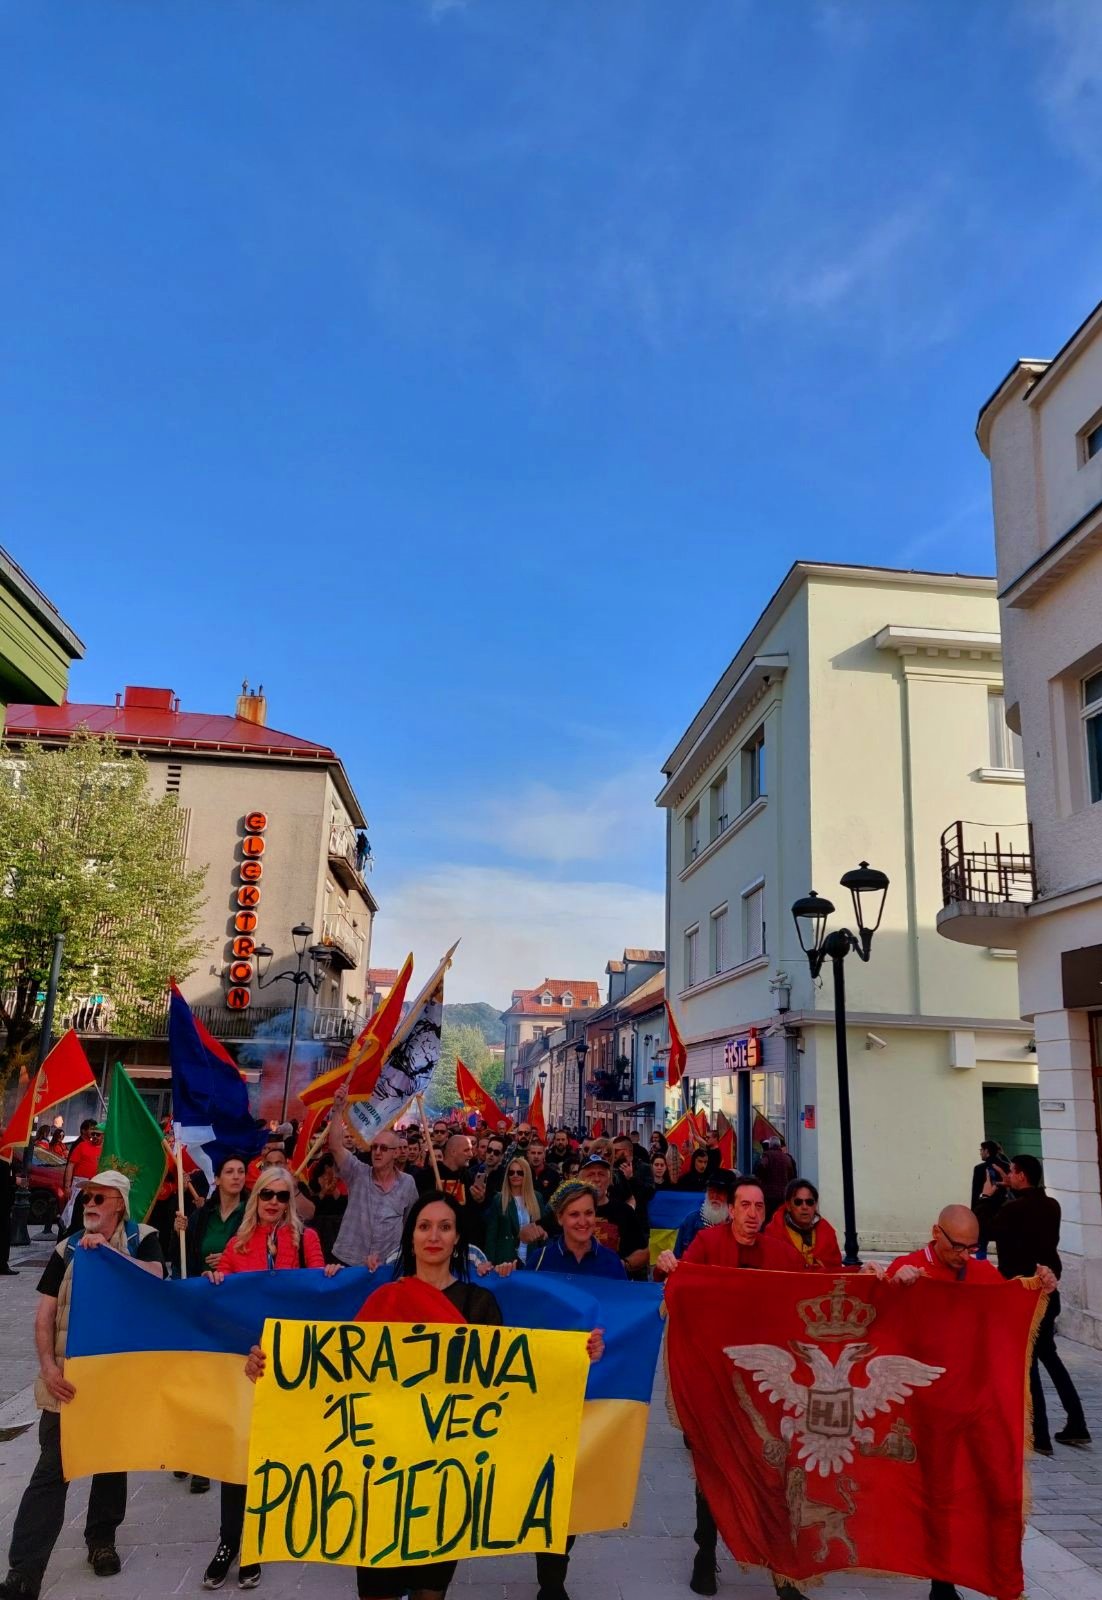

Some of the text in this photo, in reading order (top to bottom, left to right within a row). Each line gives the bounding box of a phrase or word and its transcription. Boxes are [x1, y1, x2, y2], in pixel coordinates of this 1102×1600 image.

[229, 812, 266, 1007] ELEKTRON
[724, 1040, 747, 1069] ERSTE
[272, 1321, 537, 1393] UKRAJINA
[323, 1392, 509, 1453] JE VEĆ
[247, 1450, 555, 1565] POBIJEDILA
